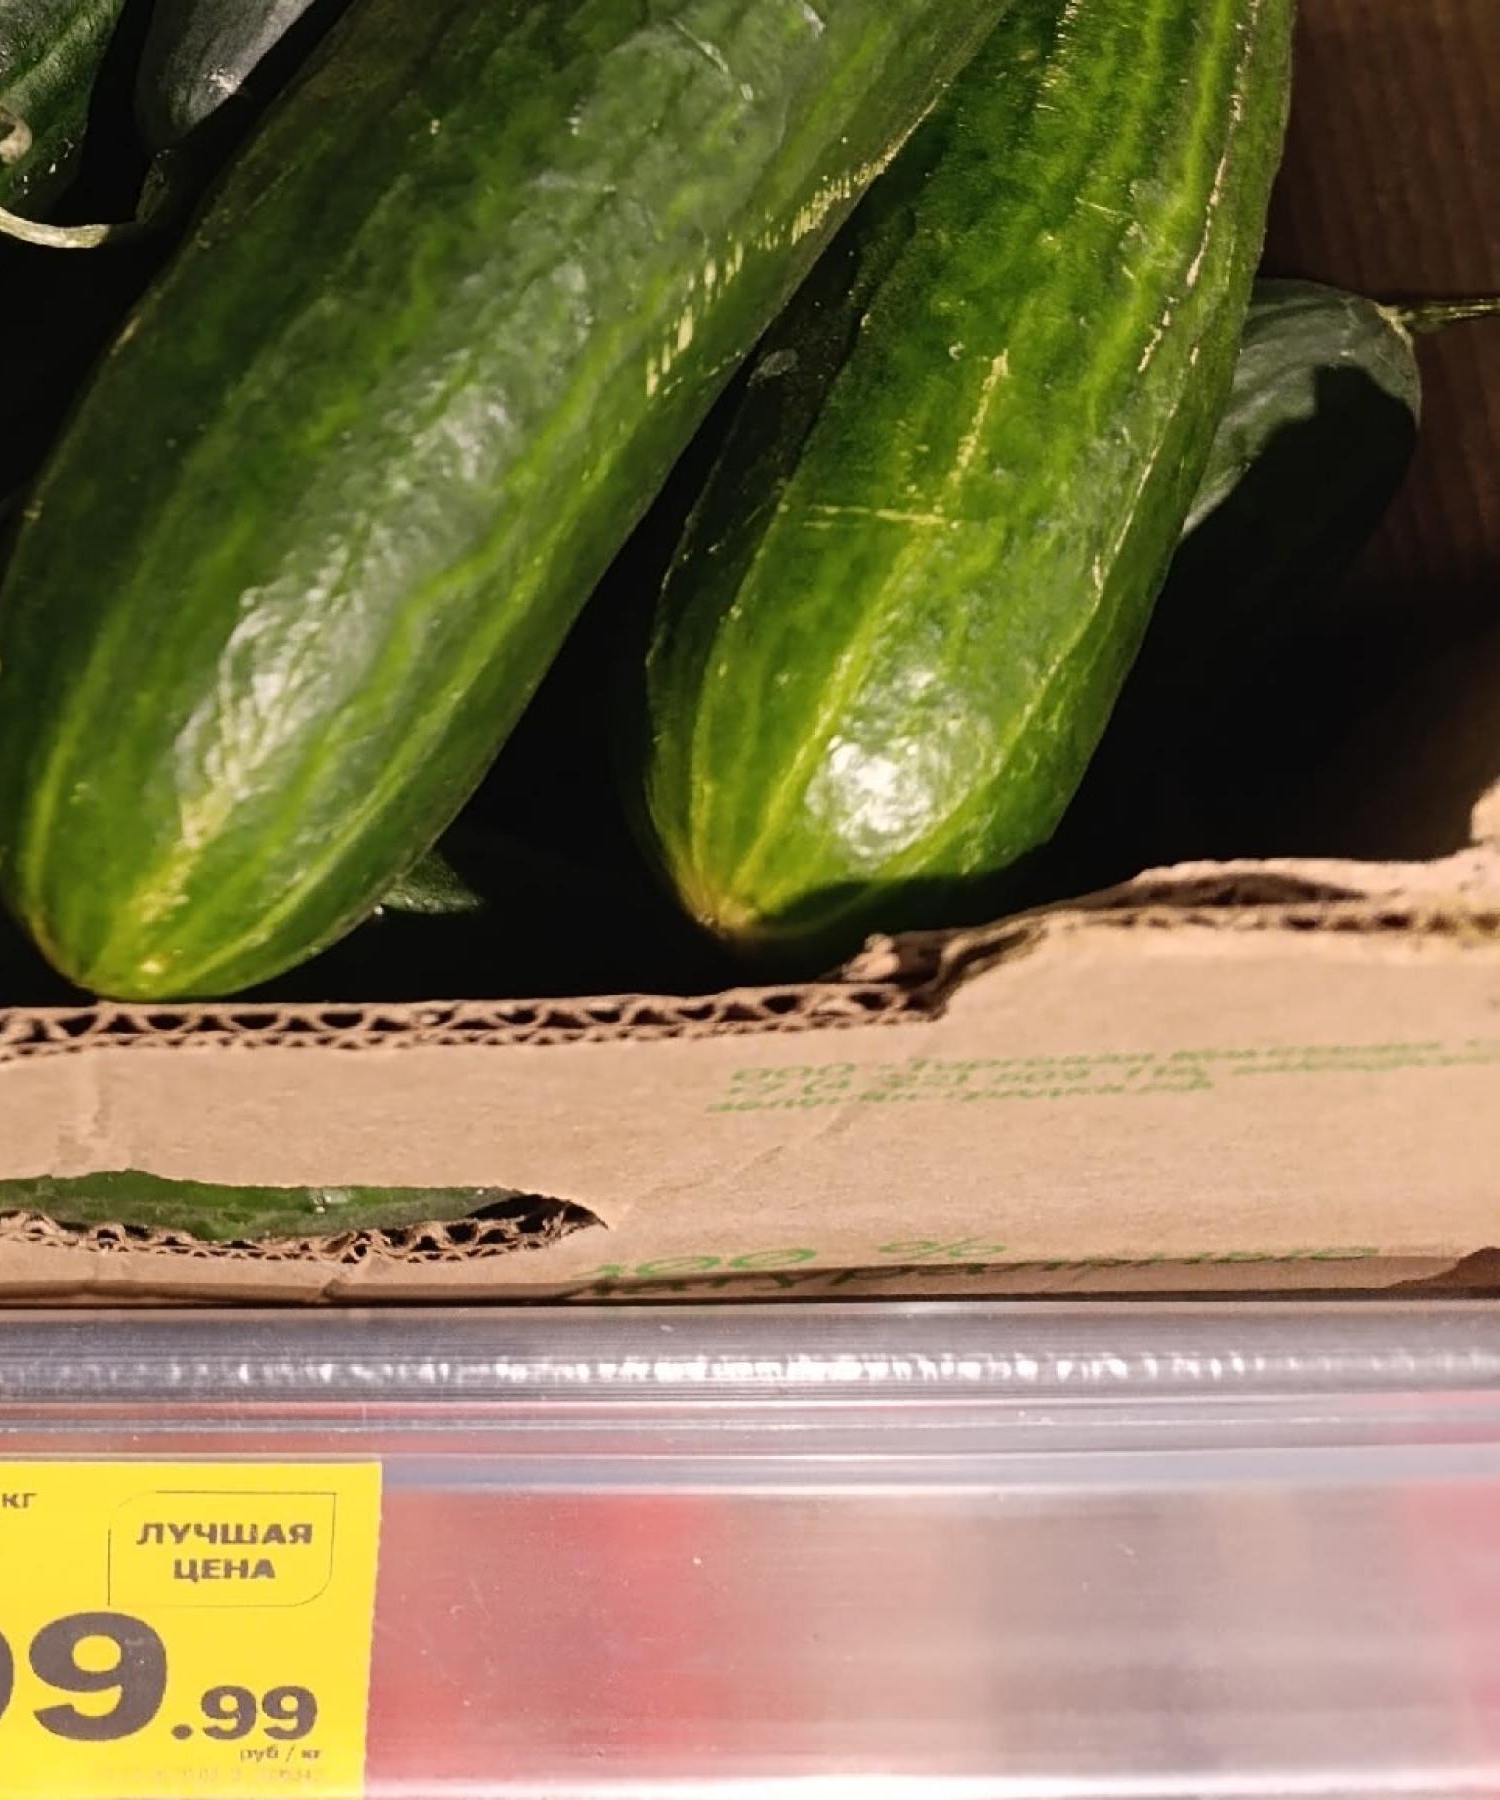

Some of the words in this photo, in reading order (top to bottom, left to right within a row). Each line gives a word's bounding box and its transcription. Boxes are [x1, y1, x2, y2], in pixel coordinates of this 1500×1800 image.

[569, 1247, 818, 1281] 100
[878, 1236, 1008, 1262] %
[135, 1522, 313, 1546] ЛУЧШАЯ
[173, 1558, 276, 1584] ЦЕНА
[240, 1744, 279, 1763] руб
